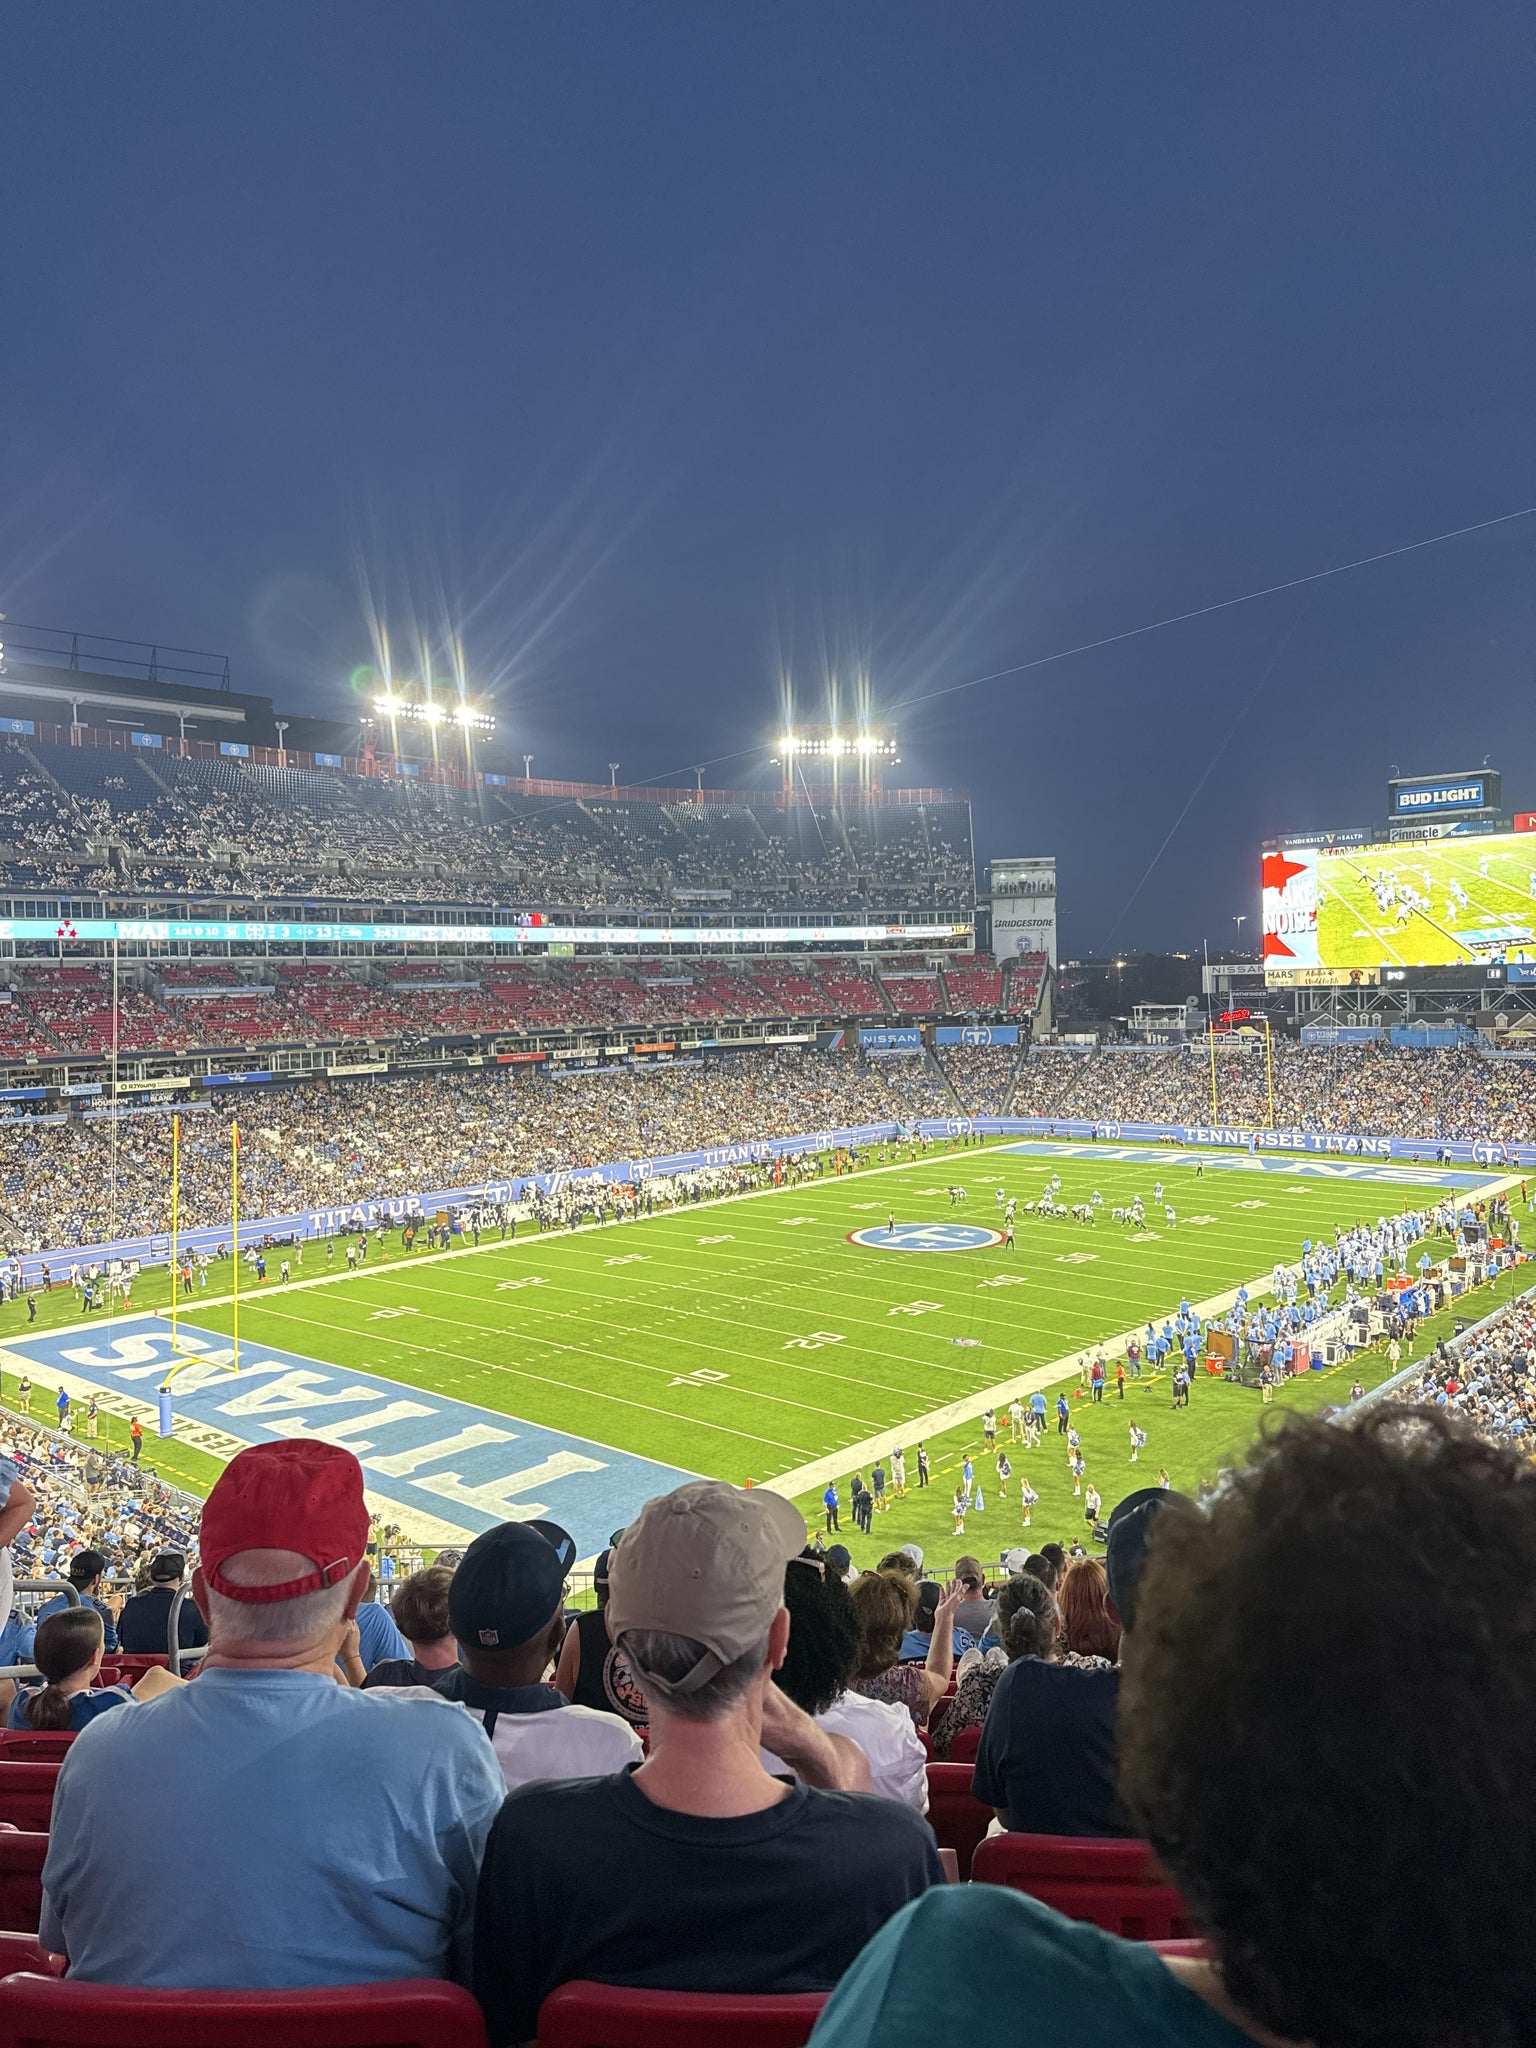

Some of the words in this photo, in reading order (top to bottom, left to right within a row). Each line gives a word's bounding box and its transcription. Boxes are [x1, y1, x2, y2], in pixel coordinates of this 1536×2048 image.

[1400, 793, 1431, 806] BUD
[1434, 787, 1480, 803] LIGHT
[1284, 836, 1325, 845] VANDERBILT
[1337, 833, 1363, 841] HEALTH
[1391, 826, 1439, 841] Pinnacle
[994, 919, 1054, 928] BRIDGESTONE
[1263, 909, 1317, 935] NOISE
[205, 926, 219, 936] 10
[282, 926, 290, 938] 3
[316, 926, 332, 938] 13
[374, 928, 399, 938] 3:43
[1212, 965, 1264, 974] NISSAN
[1267, 970, 1294, 979] MARS
[863, 1034, 917, 1043] NISSAN
[1184, 1128, 1306, 1148] TENNESSEE
[1310, 1134, 1392, 1153] TITANS
[703, 1146, 750, 1164] TITAN
[750, 1143, 771, 1157] UP
[1042, 1144, 1446, 1184] TITANS
[308, 1203, 385, 1231] TITAN
[388, 1198, 421, 1218] UP
[604, 1253, 652, 1267] 30
[1053, 1251, 1101, 1264] 50
[496, 1276, 550, 1291] 20
[978, 1273, 1028, 1288] 40
[368, 1305, 421, 1320] 10
[889, 1299, 945, 1316] 30
[782, 1330, 847, 1350] 20
[1214, 1361, 1222, 1370] G
[668, 1367, 731, 1387] 10
[82, 1391, 123, 1405] US
[111, 1403, 154, 1417] OF
[60, 1333, 610, 1521] TITANS
